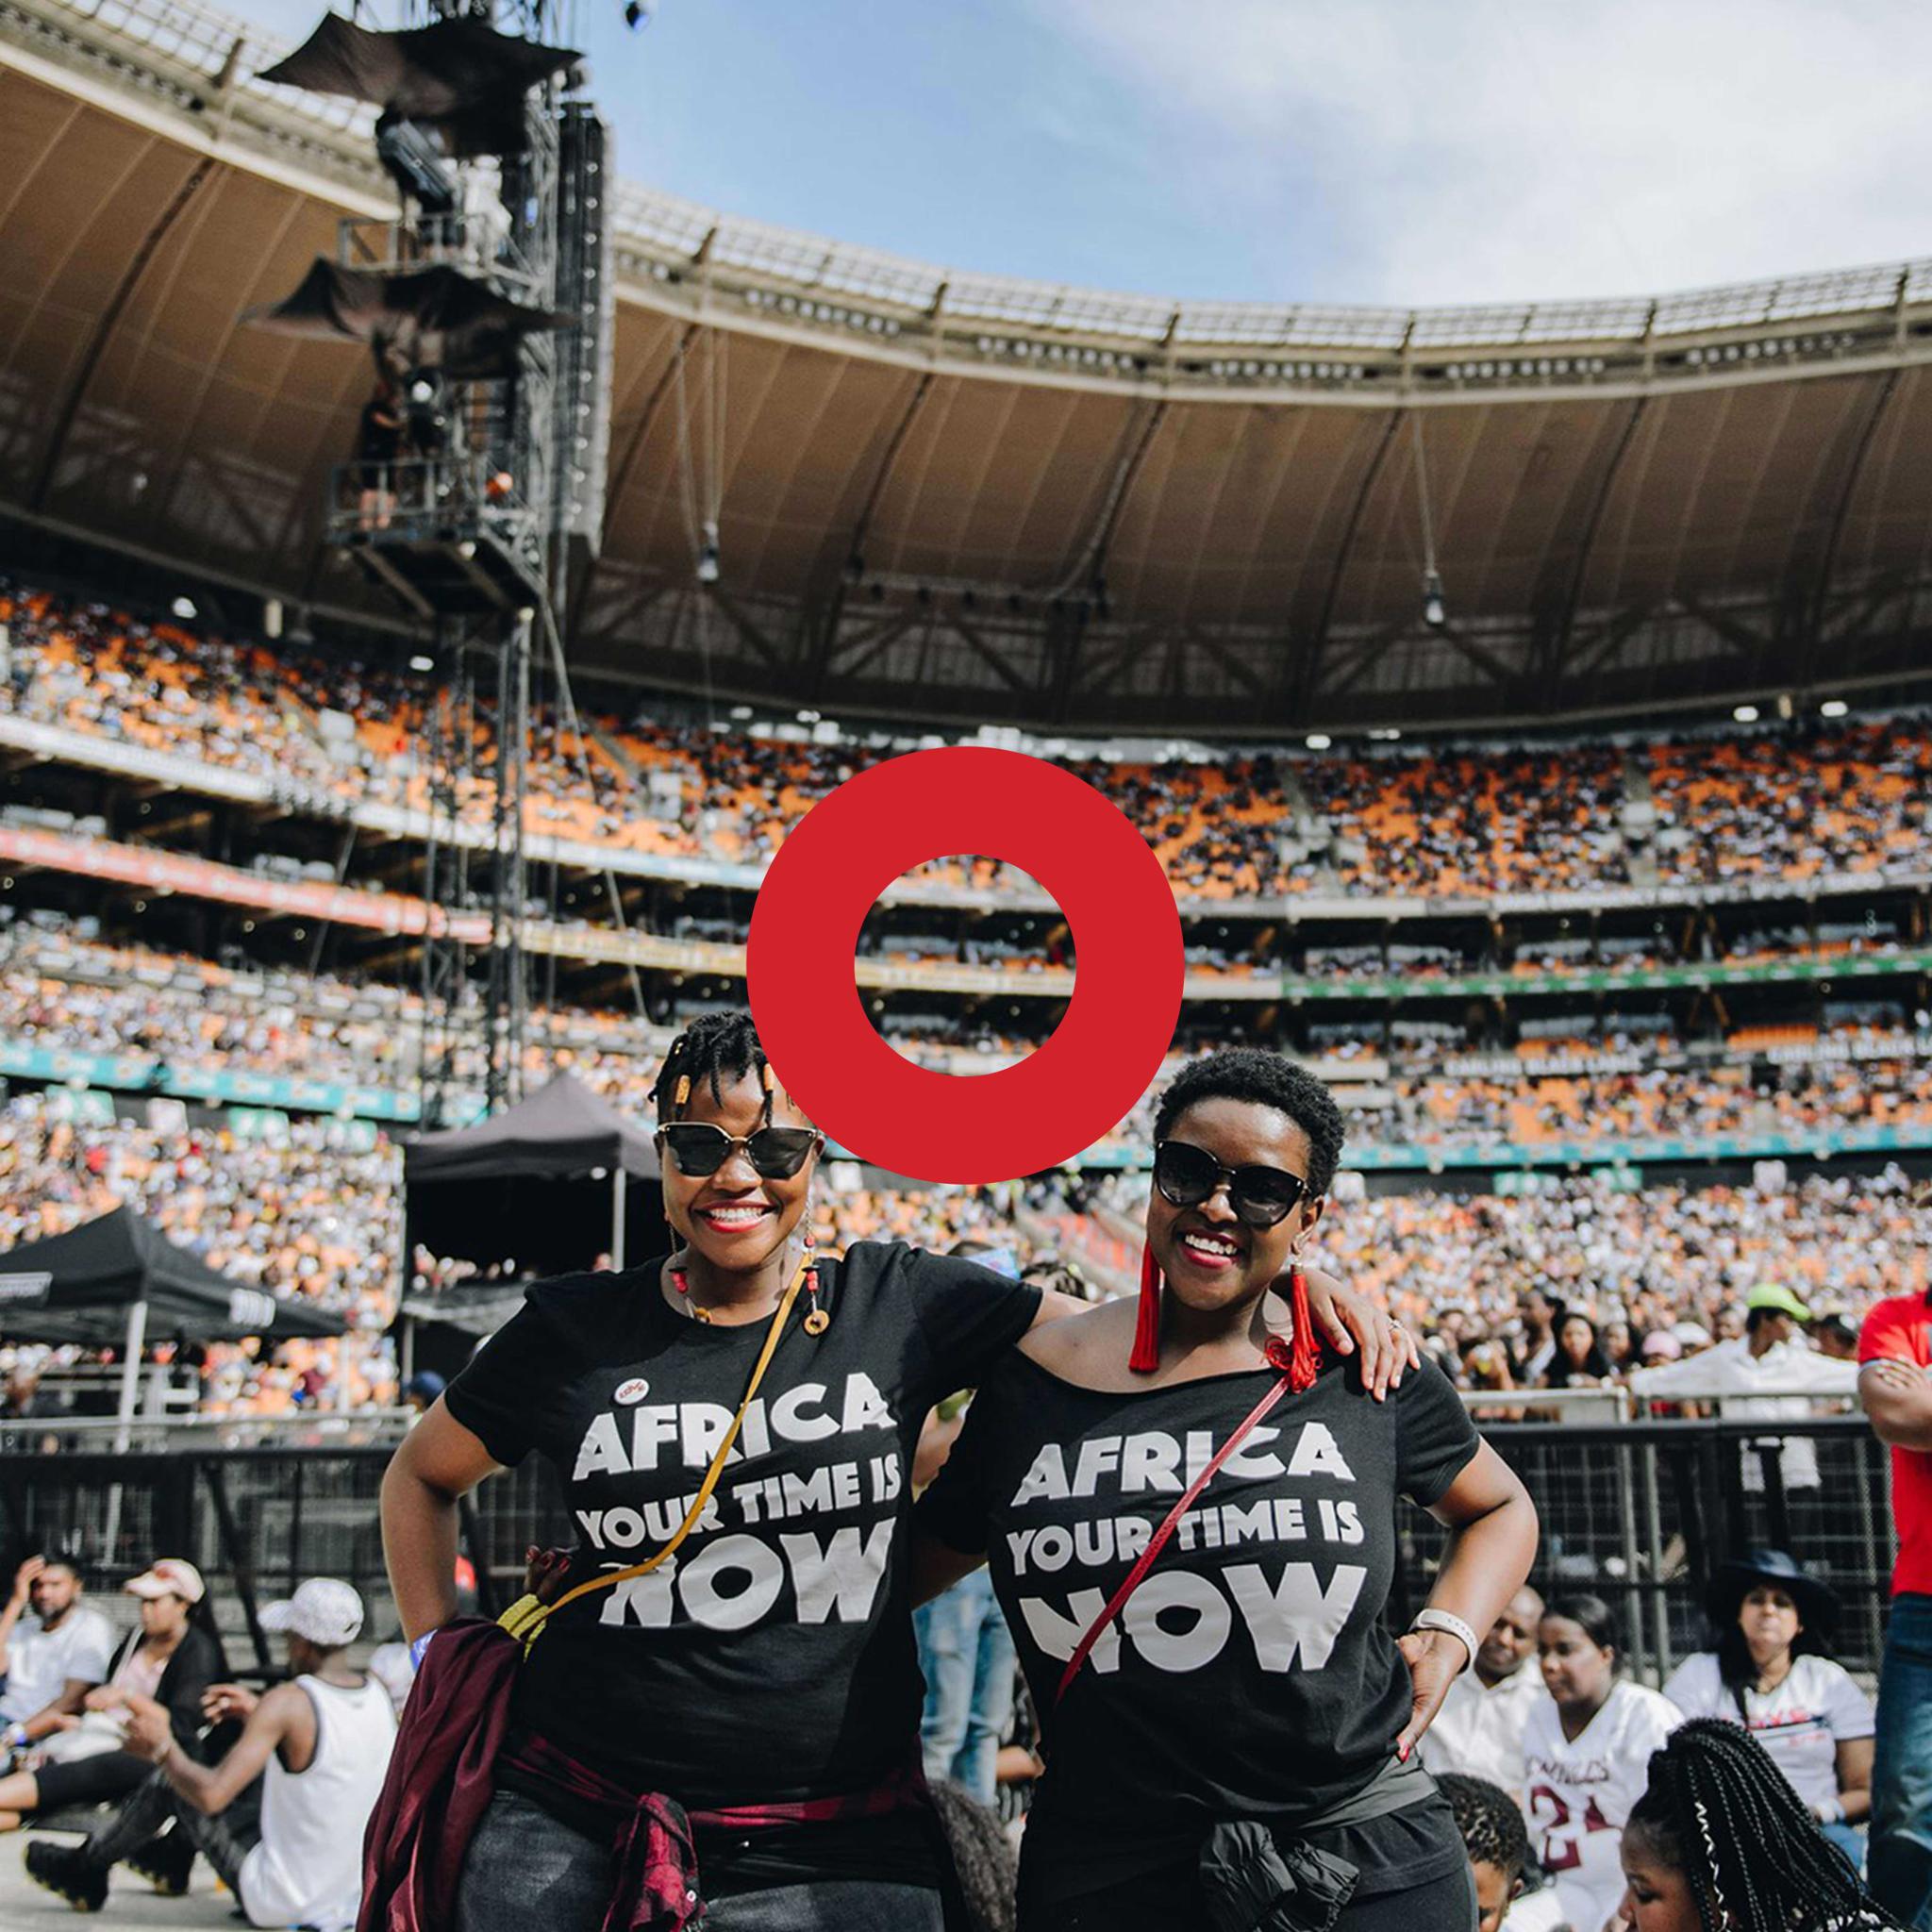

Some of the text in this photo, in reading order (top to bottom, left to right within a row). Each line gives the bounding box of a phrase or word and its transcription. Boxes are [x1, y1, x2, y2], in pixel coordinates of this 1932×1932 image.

[572, 1372, 898, 1481] AFRICA
[1010, 1422, 1357, 1507] AFRICA
[575, 1453, 902, 1550] YOUR TIME IS
[1006, 1499, 1365, 1575] YOUR TIME IS
[598, 1516, 897, 1631] NOW
[1019, 1562, 1368, 1674] NOW
